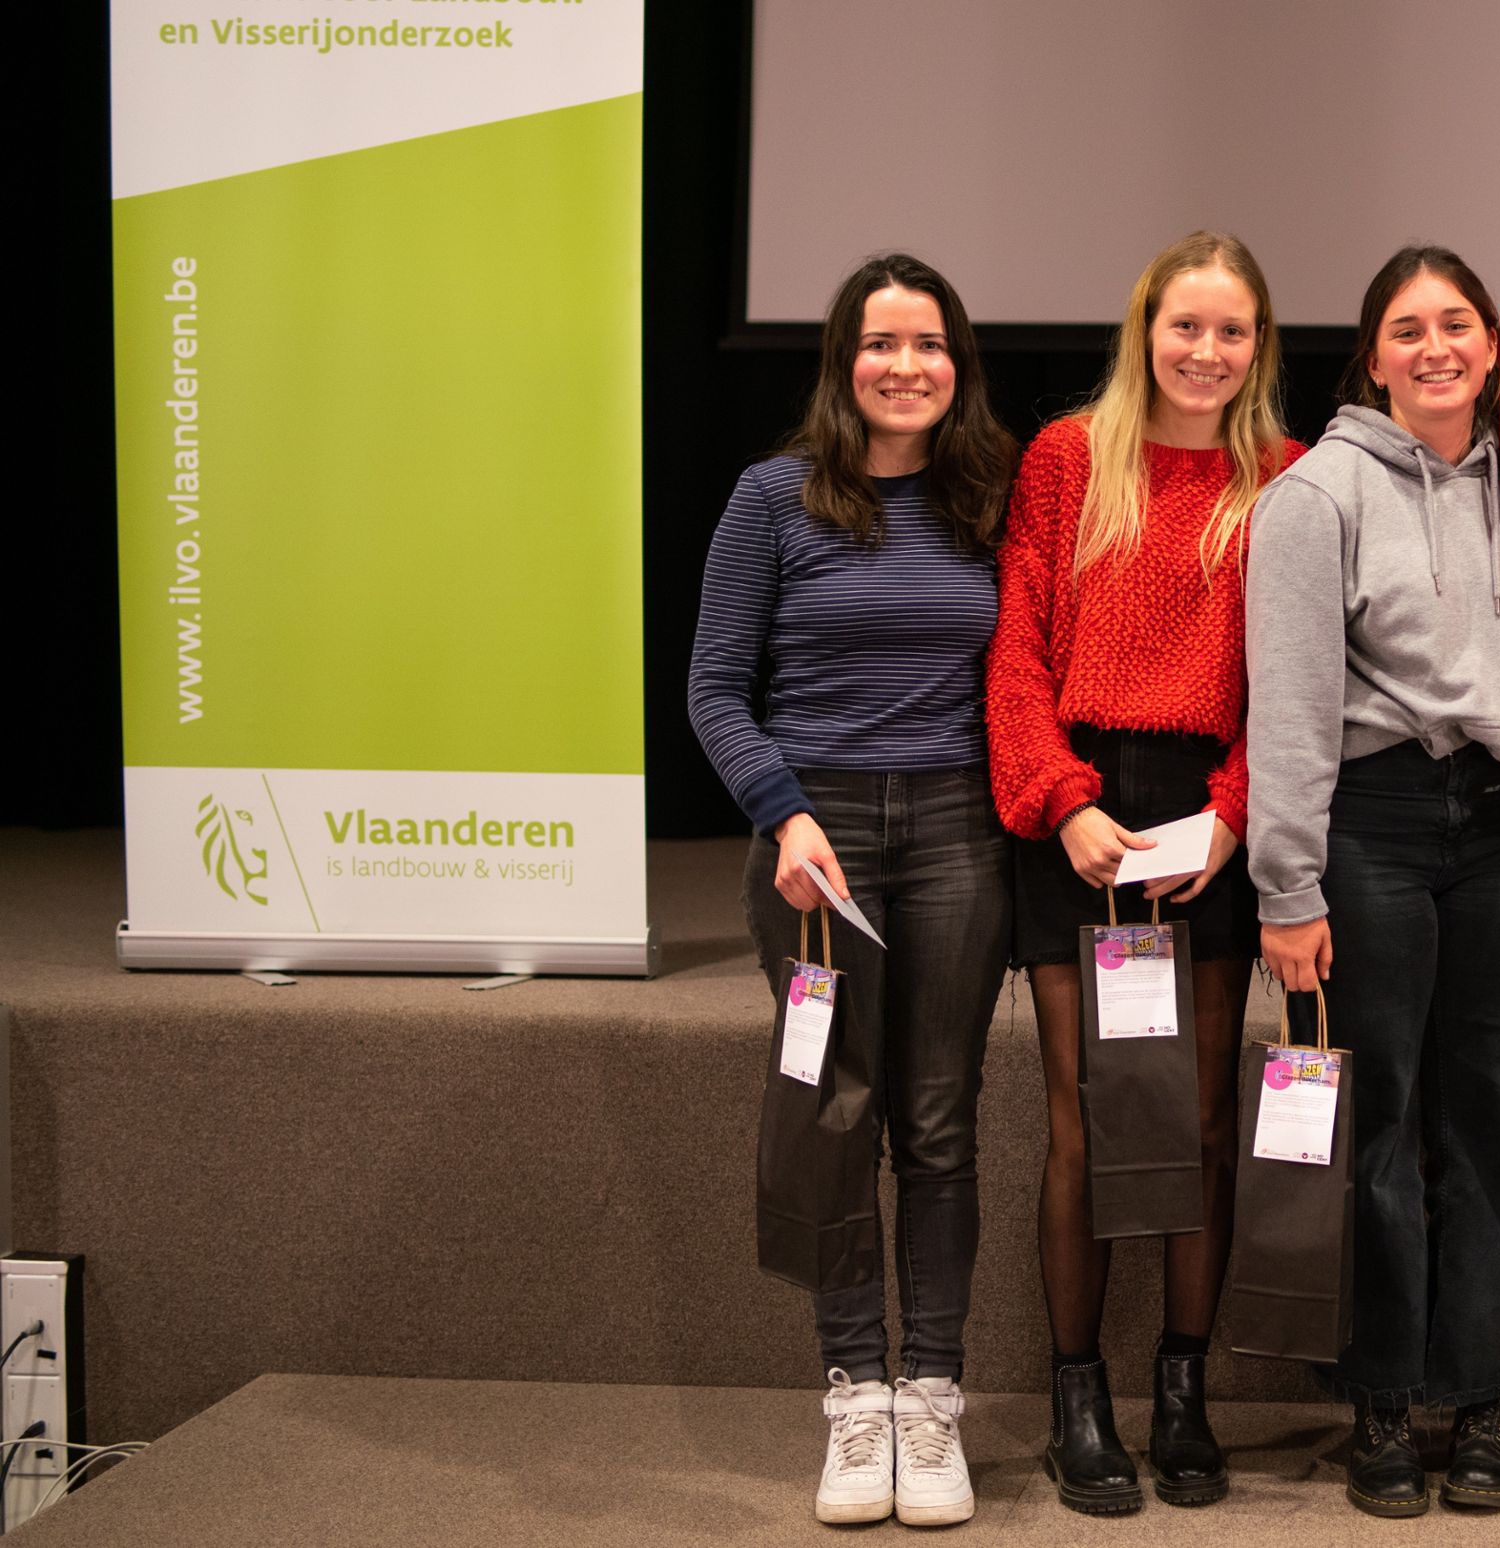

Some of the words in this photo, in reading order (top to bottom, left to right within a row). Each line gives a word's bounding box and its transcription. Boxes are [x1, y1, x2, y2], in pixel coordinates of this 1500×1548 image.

[159, 22, 198, 44] en
[211, 19, 513, 54] Visserijonderzoek
[324, 808, 575, 848] Vlaanderen
[327, 856, 343, 877] is
[351, 855, 467, 878] landbouw
[474, 858, 490, 879] &
[497, 858, 574, 888] visserij
